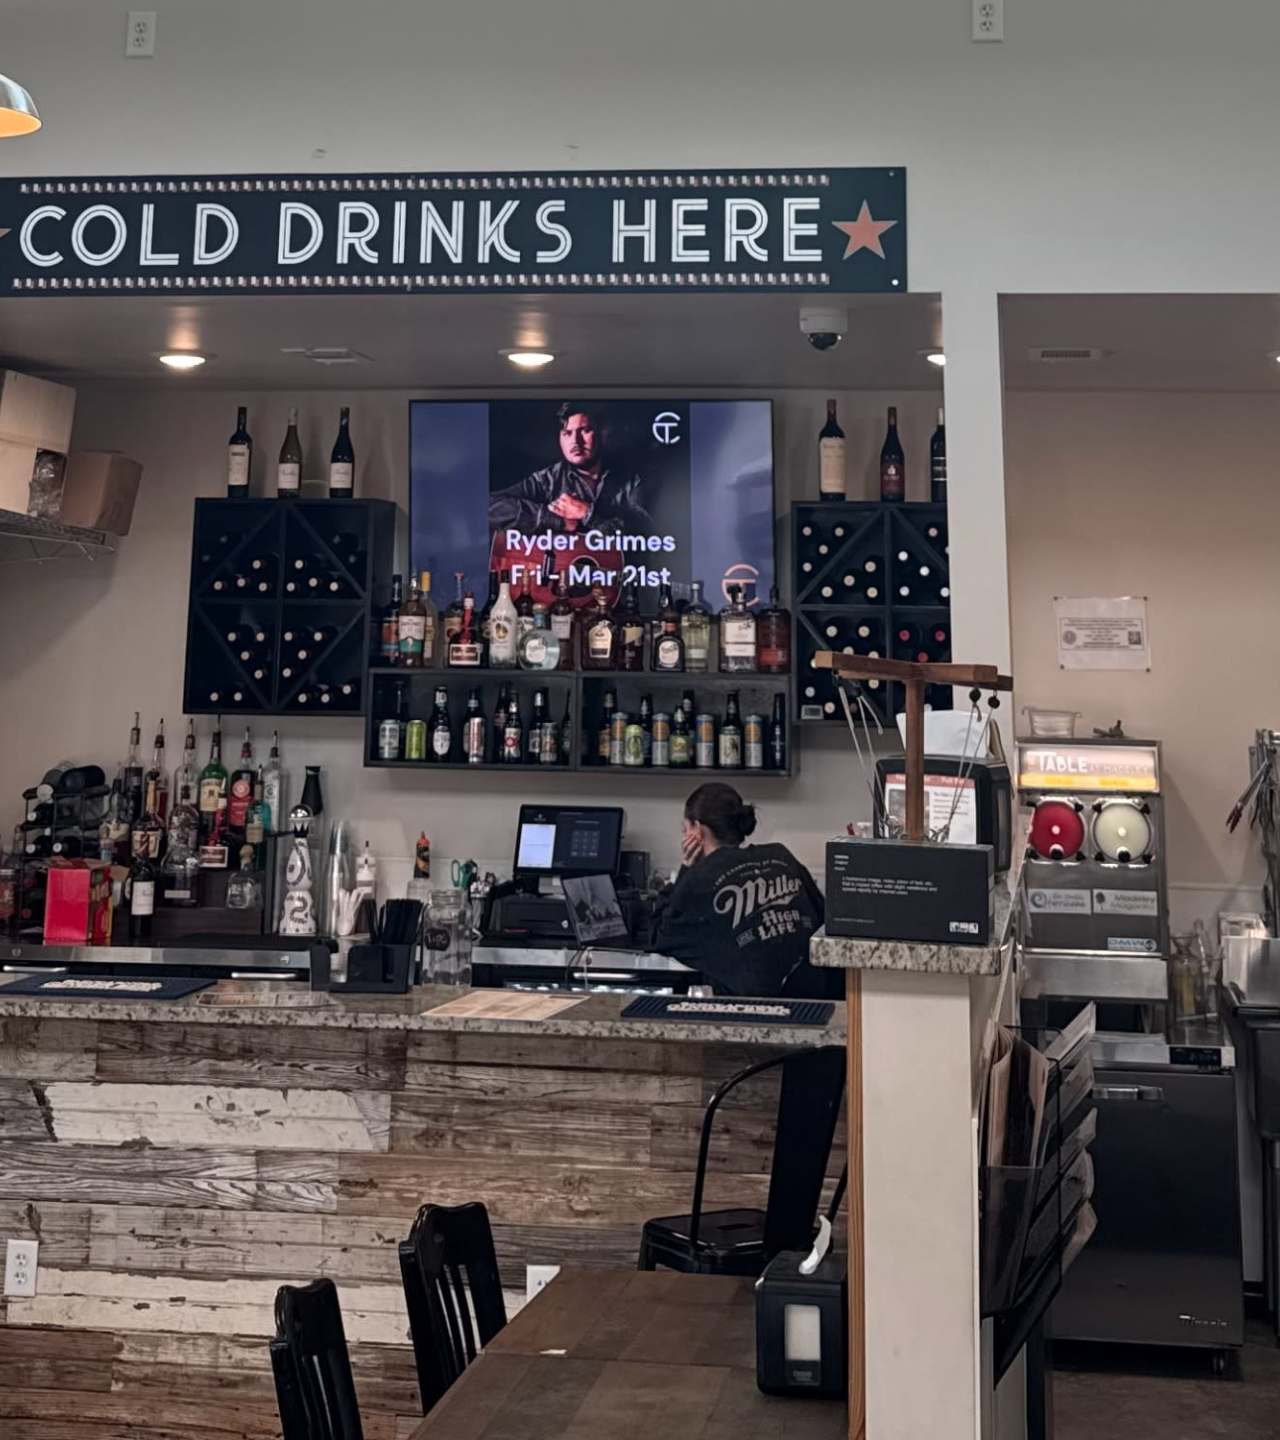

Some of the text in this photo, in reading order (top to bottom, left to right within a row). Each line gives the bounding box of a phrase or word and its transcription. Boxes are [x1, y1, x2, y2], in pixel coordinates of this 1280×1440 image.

[18, 198, 823, 268] COLD DRINKS HERE
[506, 529, 676, 556] Ryder Grimes
[569, 565, 617, 587] Mar
[1026, 751, 1089, 773] TABLE
[713, 874, 802, 929] Miller
[761, 909, 801, 927] HIGH
[758, 921, 797, 941] LIFE
